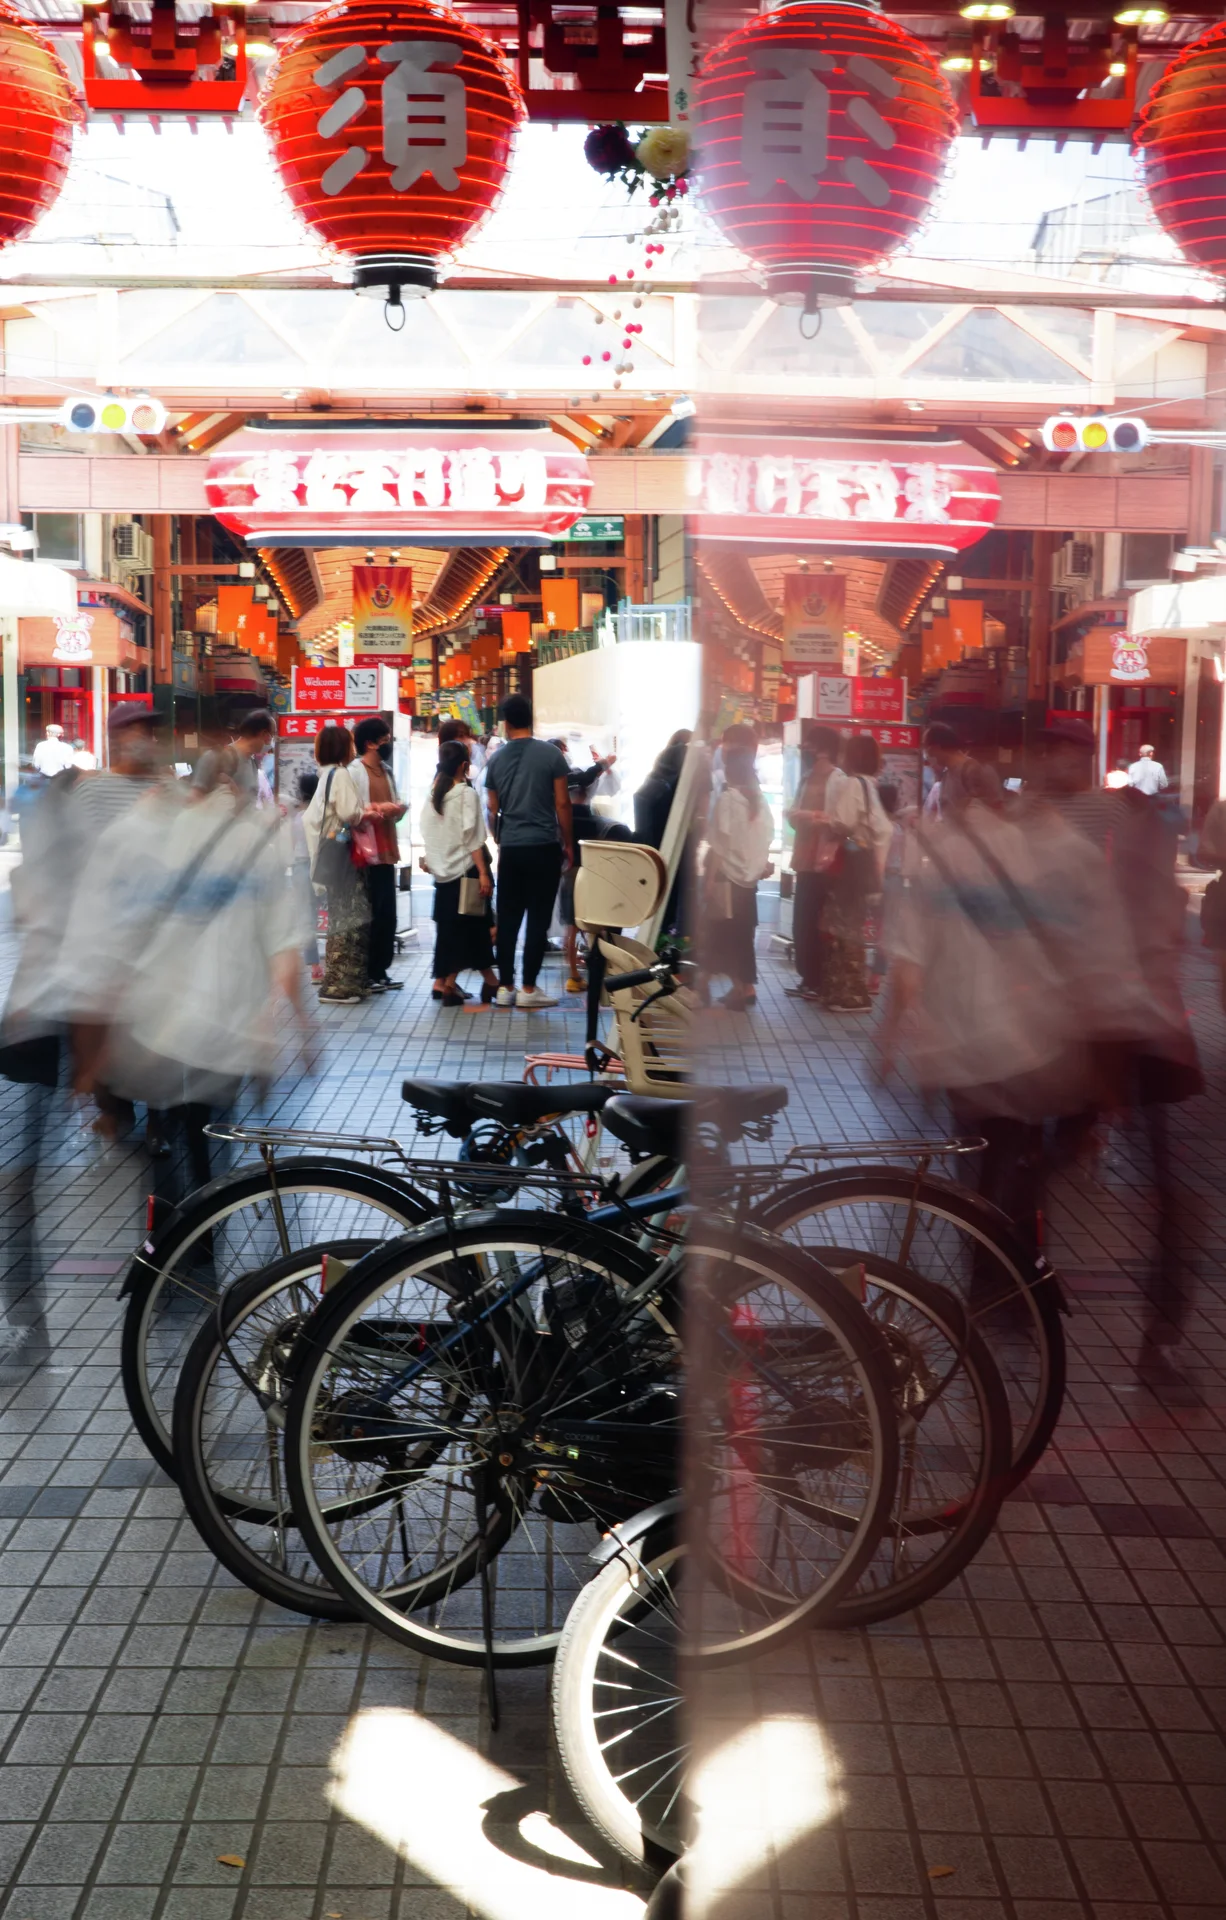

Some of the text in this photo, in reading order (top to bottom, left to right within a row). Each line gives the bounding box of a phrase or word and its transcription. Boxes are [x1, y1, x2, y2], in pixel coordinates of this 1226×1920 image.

[313, 40, 468, 196] 須
[303, 676, 341, 686] Welcome
[347, 673, 376, 689] N-2
